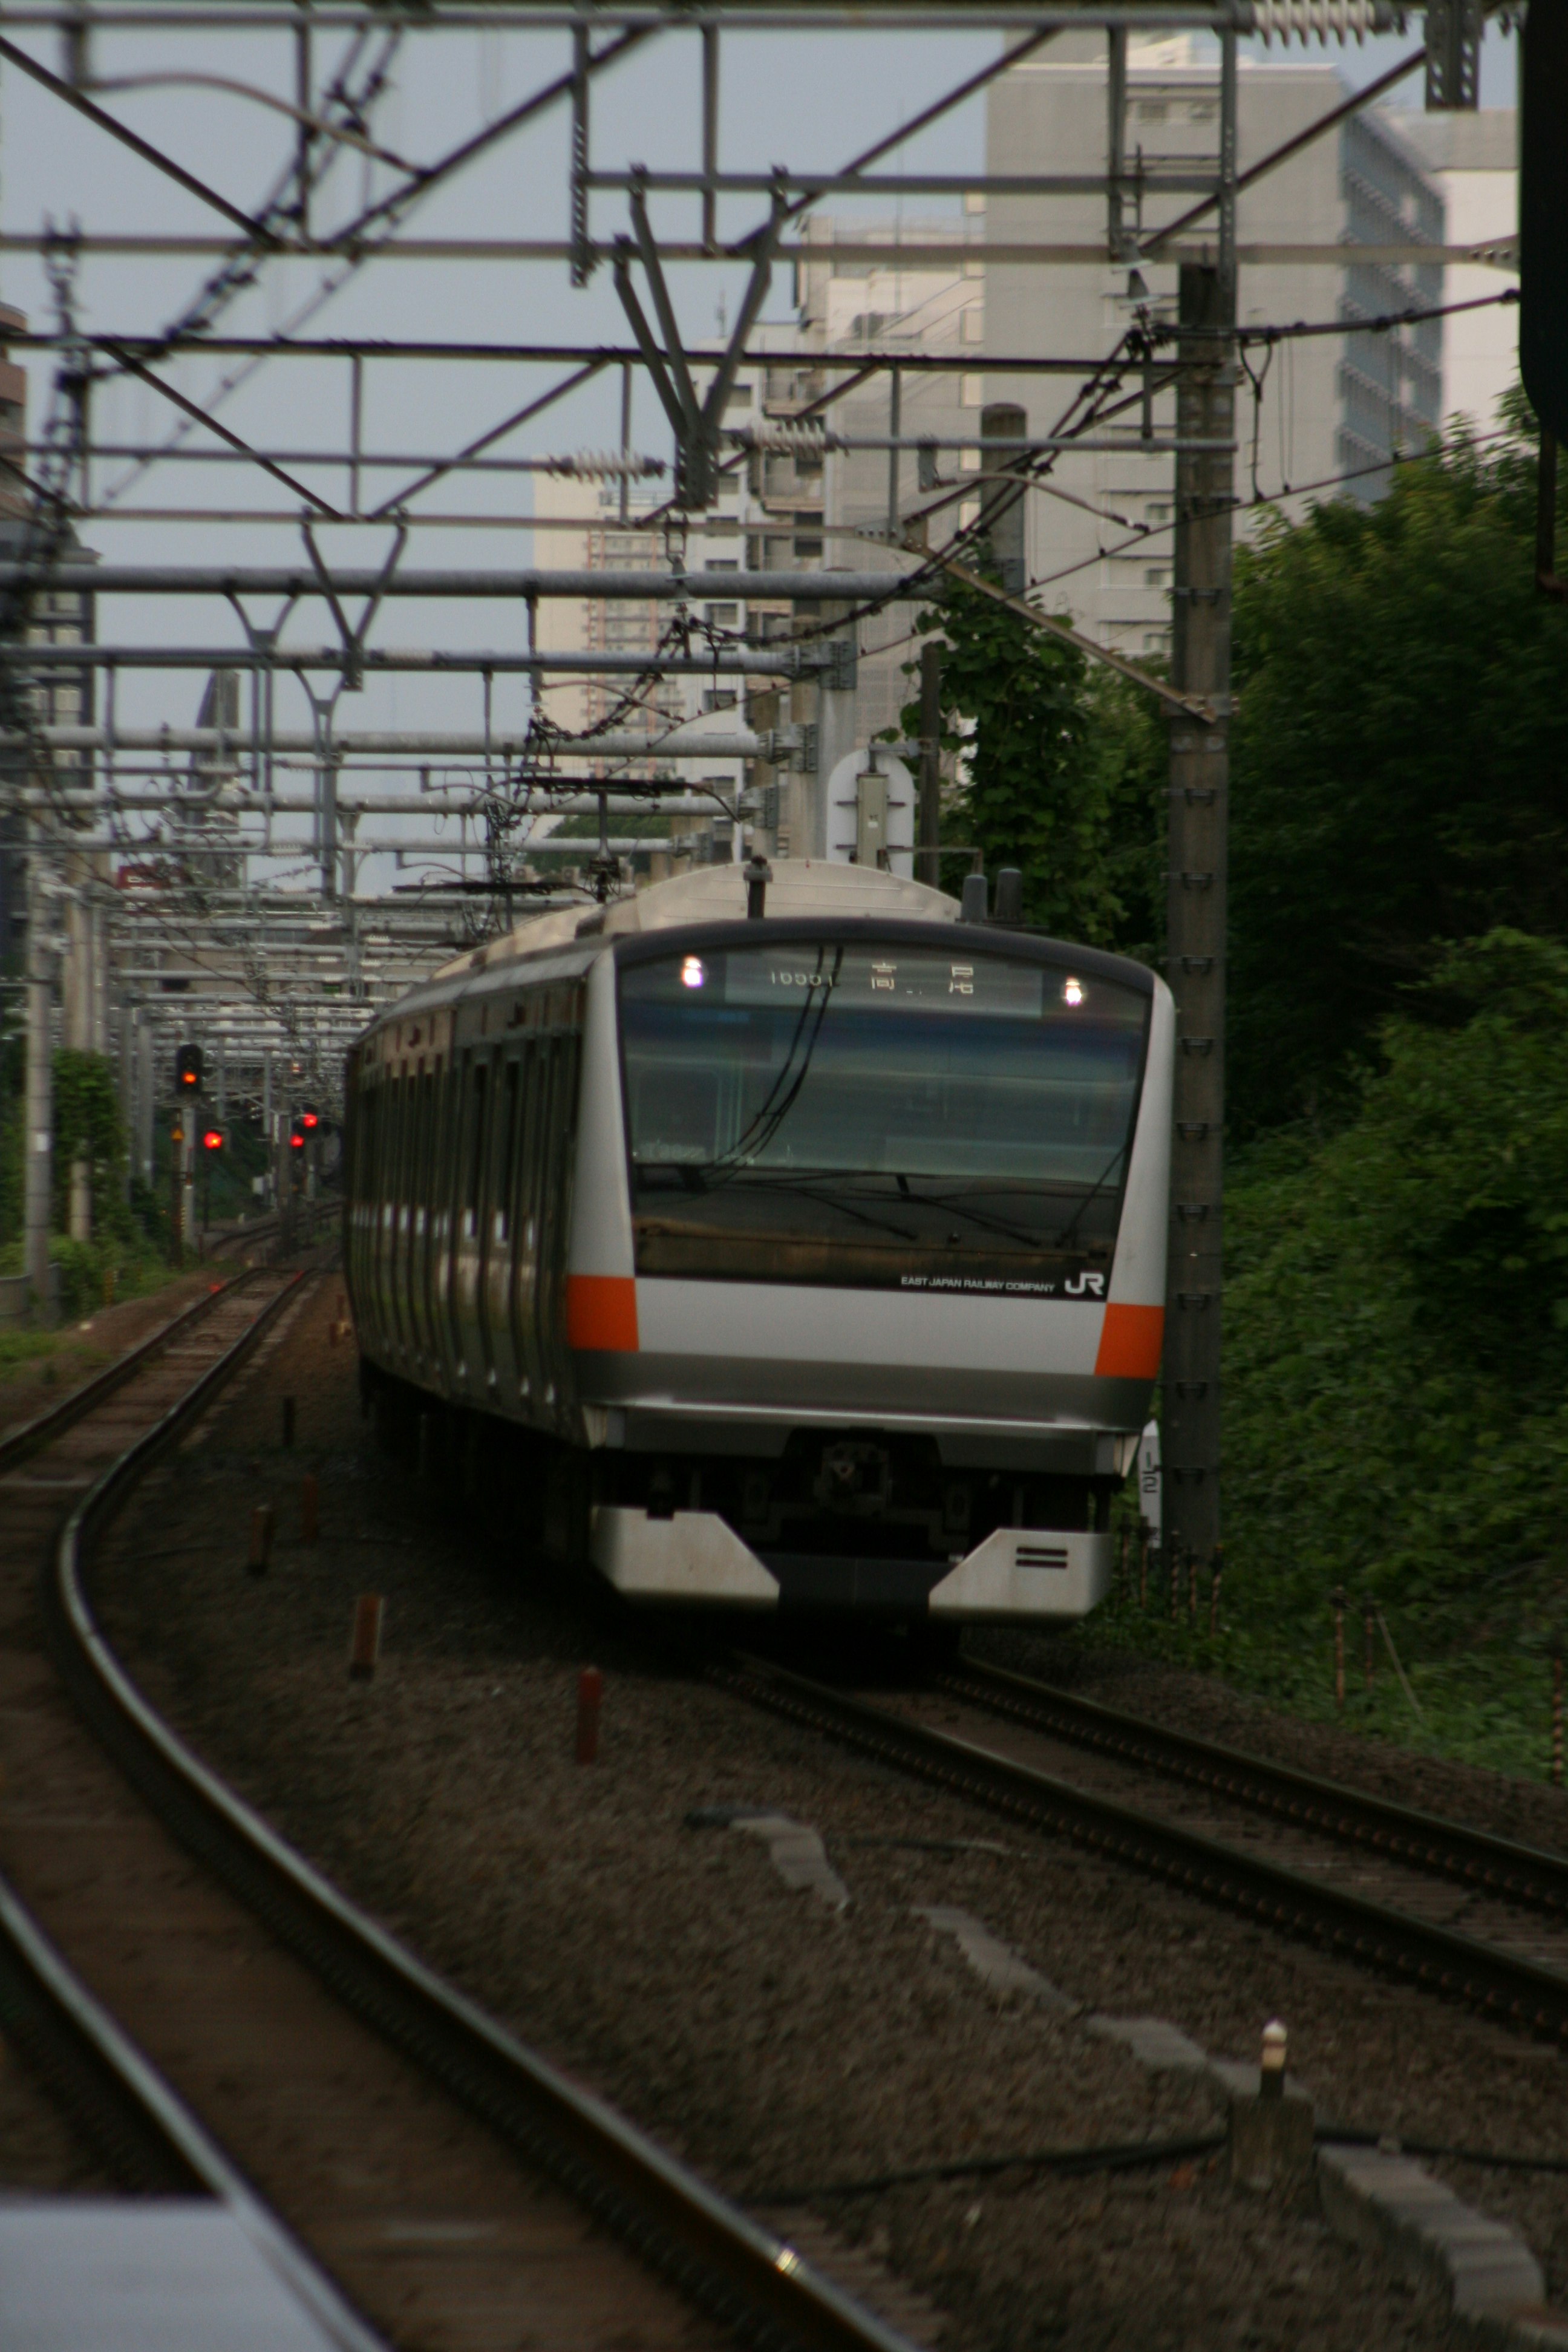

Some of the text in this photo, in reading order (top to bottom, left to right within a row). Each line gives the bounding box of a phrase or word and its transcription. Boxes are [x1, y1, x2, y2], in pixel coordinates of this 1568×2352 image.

[901, 1276, 1056, 1292] EAST JAPAN RAILWAY COMPANY
[1065, 1272, 1105, 1295] JR
